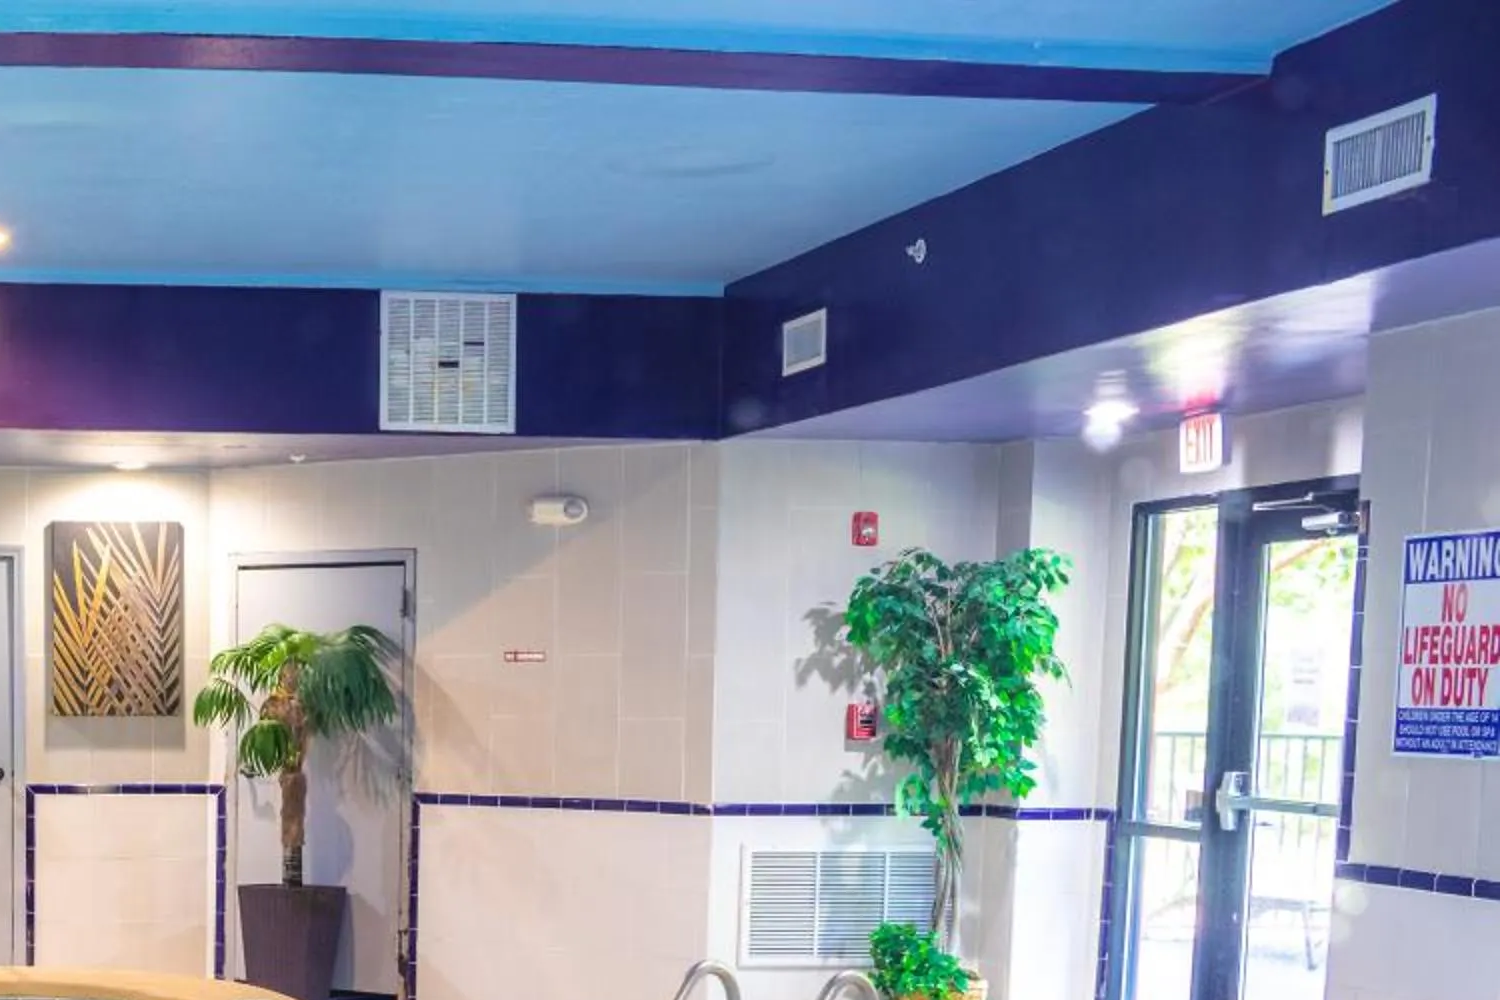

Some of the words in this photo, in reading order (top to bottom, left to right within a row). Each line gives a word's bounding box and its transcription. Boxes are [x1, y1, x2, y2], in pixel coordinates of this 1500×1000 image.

[1186, 417, 1213, 465] EXIT
[1441, 583, 1468, 623] NO
[1404, 625, 1500, 665] LIFEGUARD
[1411, 670, 1435, 706] ON
[1441, 667, 1490, 708] DUTY
